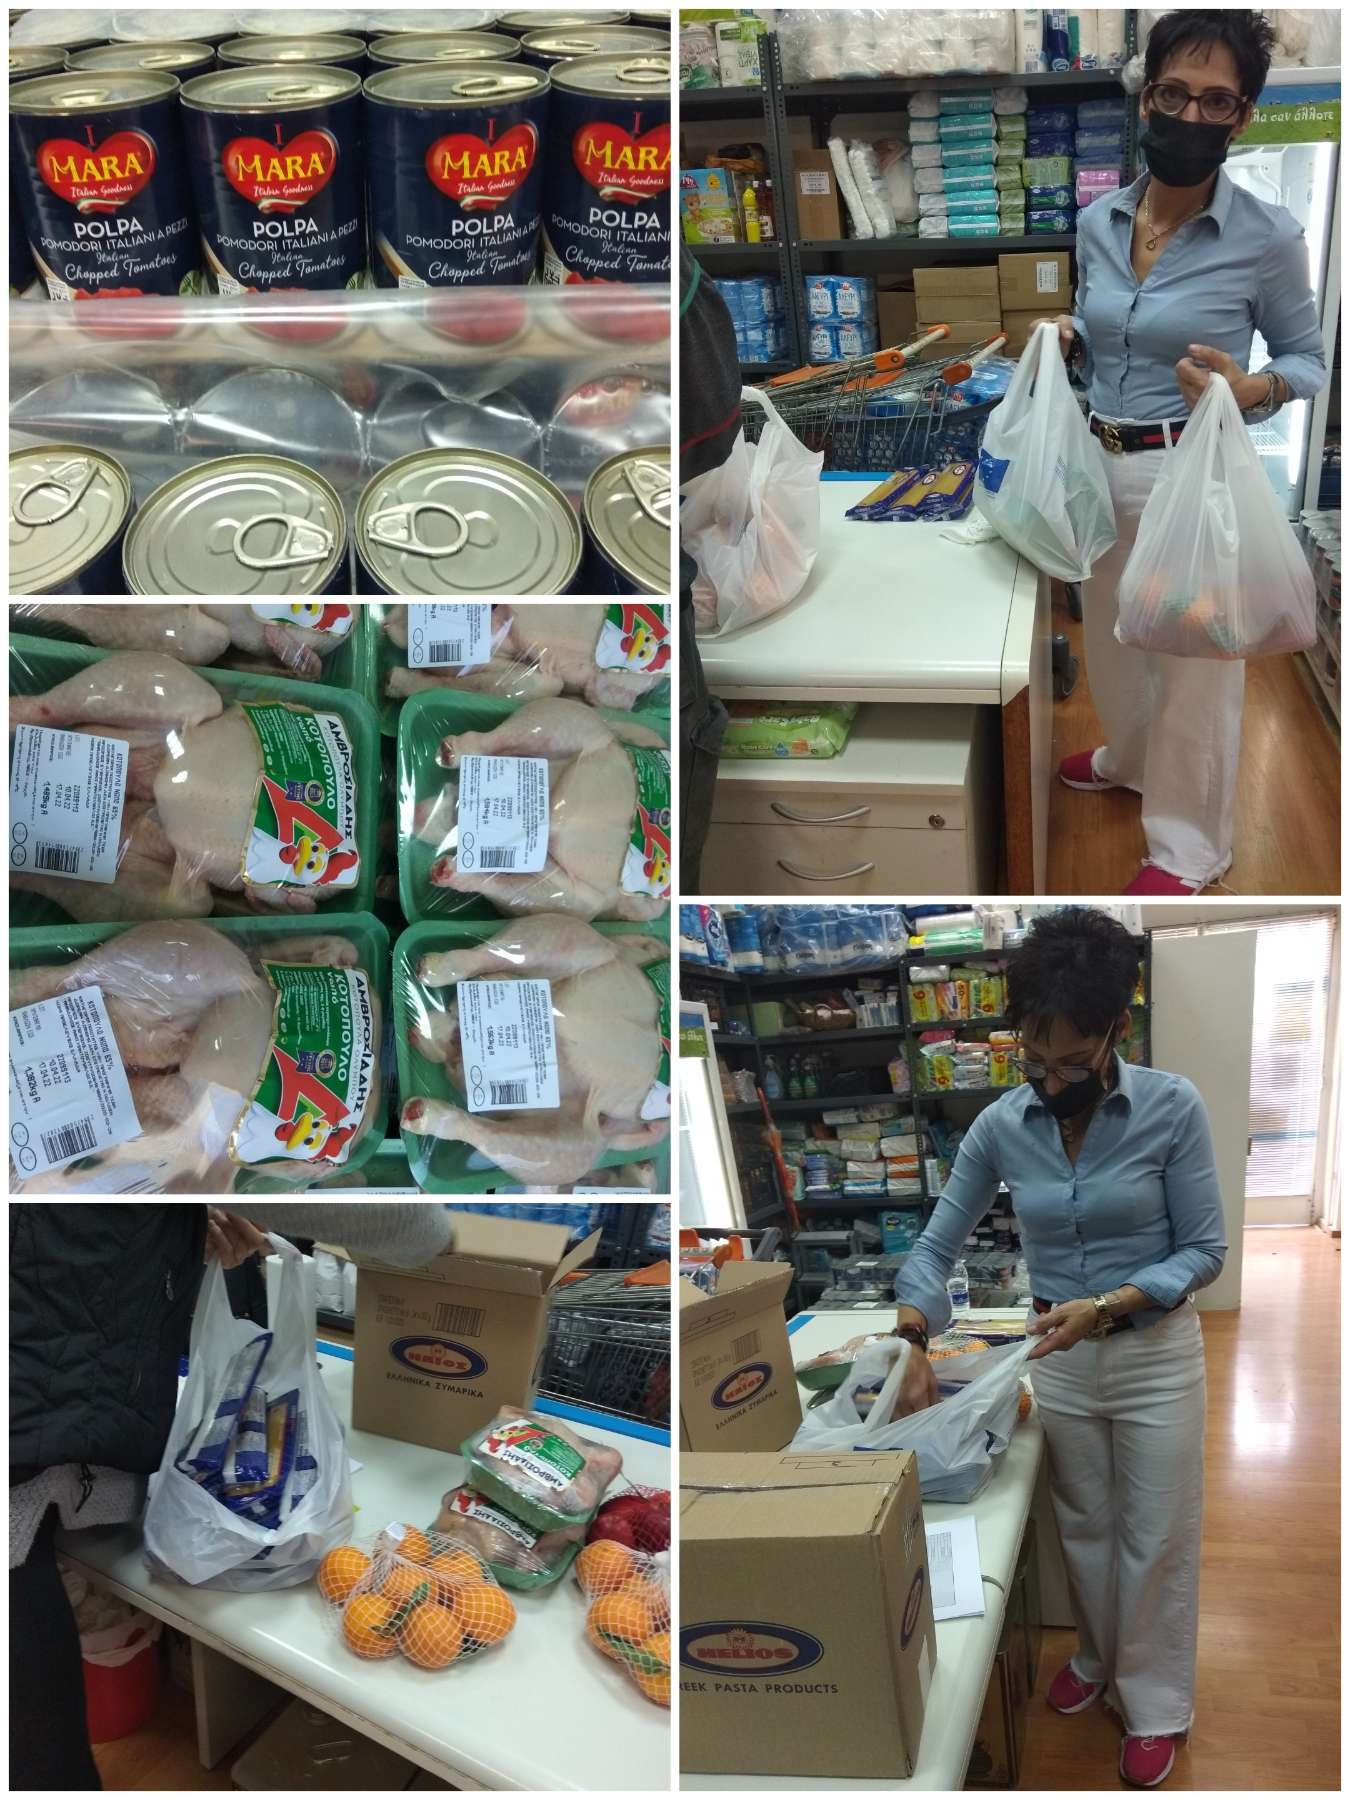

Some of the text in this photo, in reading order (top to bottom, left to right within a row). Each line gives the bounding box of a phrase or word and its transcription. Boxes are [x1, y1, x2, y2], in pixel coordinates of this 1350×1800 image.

[1251, 108, 1267, 123] λα
[1294, 106, 1334, 121] άλλοτε
[50, 152, 144, 183] MARA
[235, 152, 325, 182] MARA
[441, 147, 527, 179] MARA
[253, 184, 313, 197] Italian Goodness
[458, 183, 485, 195] Italian
[598, 172, 664, 187] Italian Goodness
[71, 183, 133, 199] Italian Goodness
[74, 216, 143, 239] POLPA
[252, 217, 319, 239] POLPA
[452, 212, 514, 237] POLPA
[552, 213, 611, 241] POMODORI
[589, 207, 661, 229] POLPA
[41, 236, 102, 252] POMODORI
[106, 232, 155, 250] ITALIANI
[158, 230, 165, 239] A
[217, 234, 277, 251] POMODORI
[282, 234, 328, 250] ITALIANI
[330, 231, 337, 240] A
[406, 234, 474, 250] POMODORI
[480, 230, 521, 248] ITALIANI
[602, 240, 637, 253] Italian
[96, 252, 129, 264] Italian
[271, 252, 303, 264] Italian
[467, 250, 498, 263] Italian
[566, 245, 620, 272] Chopped
[65, 254, 177, 285] Chopped Tomatoes
[238, 254, 346, 284] Chopped Tomatoes
[429, 261, 486, 283] Chopped
[304, 717, 337, 810] ΚΟΤΟΠΟΥΛΟ
[327, 720, 354, 840] ΑΜΒΡΟΣΙΑΔΗΣ
[334, 974, 352, 1082] ΚΟΤΟΠΟΥΛΟ
[353, 976, 372, 1113] ΑΜΒΡΟΣΙΑΔΗΣ
[435, 1382, 483, 1398] ΖΥΜΑΡΙΚΑ
[502, 1449, 564, 1487] ΑΜΒΡΟΣΙΑΔΗΣ
[697, 1647, 794, 1659] HELIOS
[715, 1683, 759, 1693] PASTA
[765, 1684, 839, 1694] PRODUCTS
